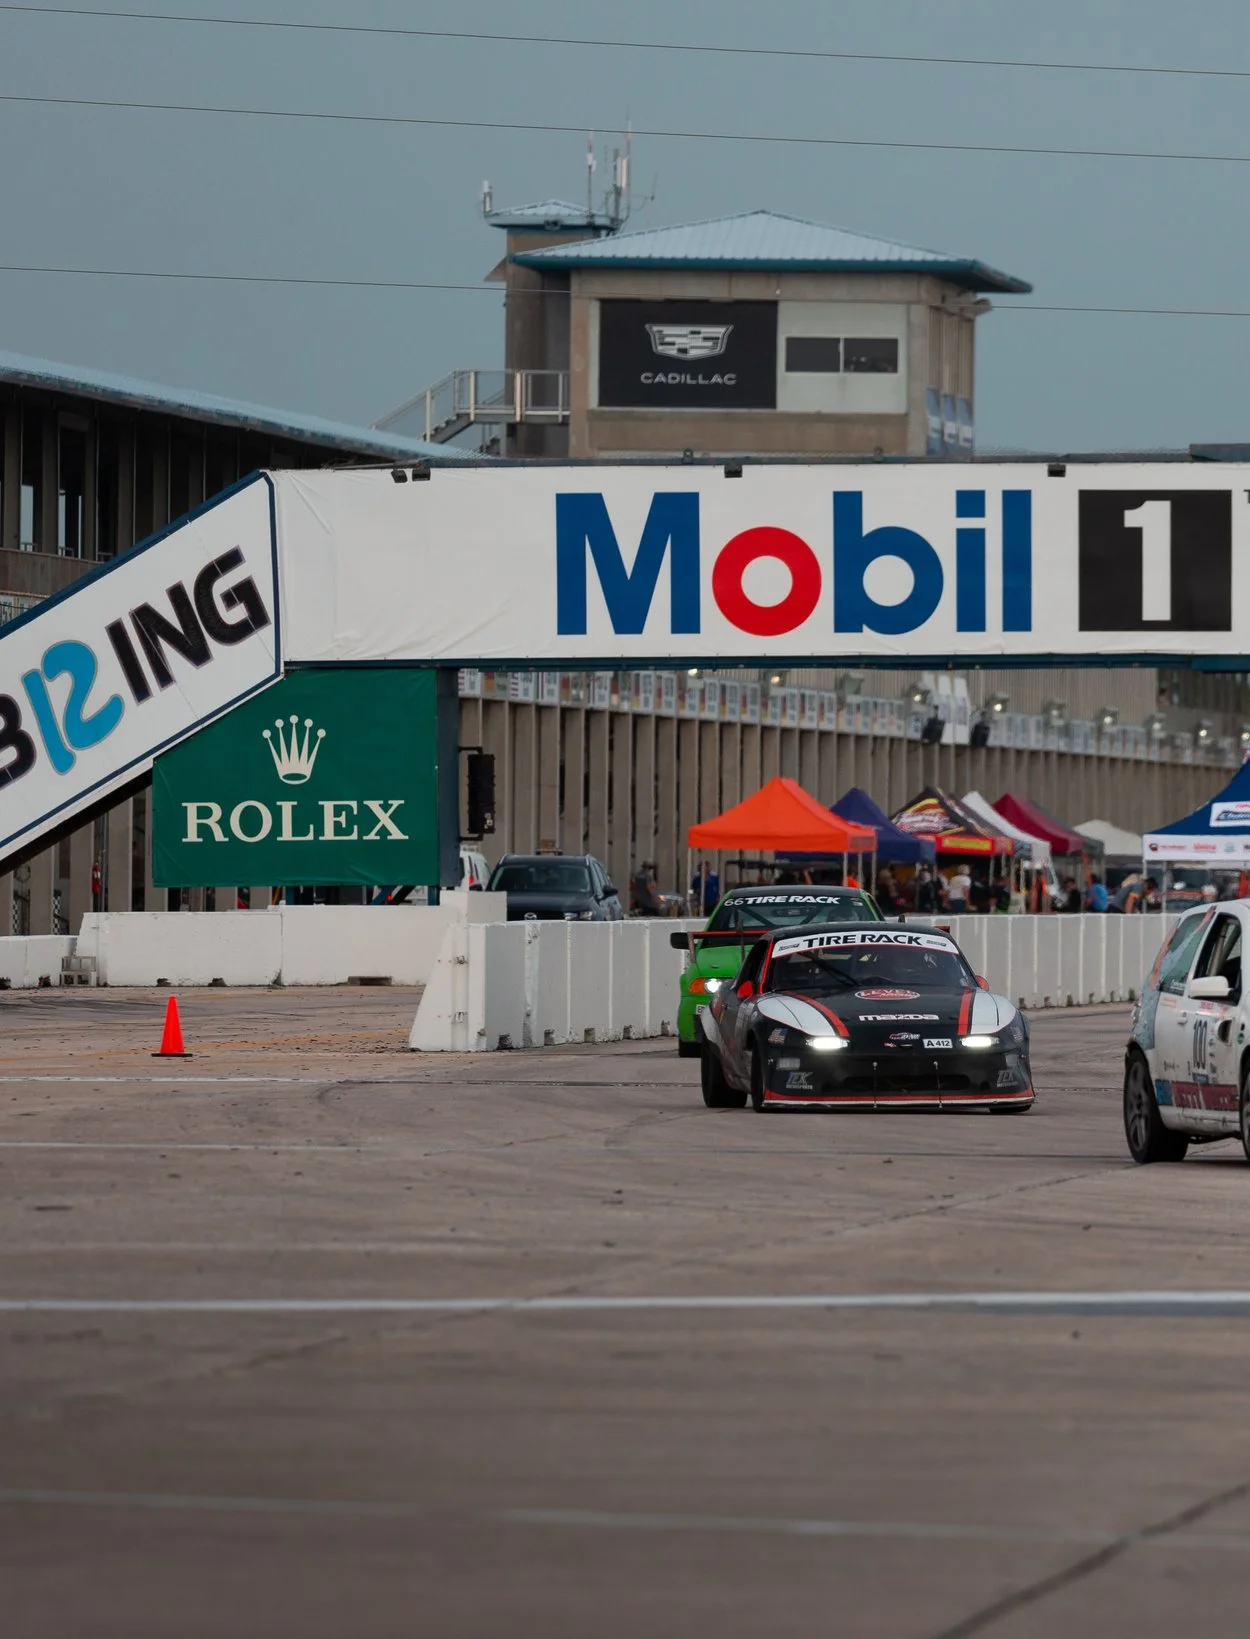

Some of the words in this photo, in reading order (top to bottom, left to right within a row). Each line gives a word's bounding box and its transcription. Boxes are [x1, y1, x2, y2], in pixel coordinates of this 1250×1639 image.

[640, 372, 737, 386] CADILLAC
[556, 490, 1032, 637] Mobil
[1124, 500, 1171, 621] 1
[182, 800, 409, 843] ROLEX
[724, 898, 744, 907] 66
[744, 896, 791, 904] TIRE
[790, 895, 840, 904] RACK
[803, 934, 856, 948] TIRE
[860, 934, 923, 946] RACK
